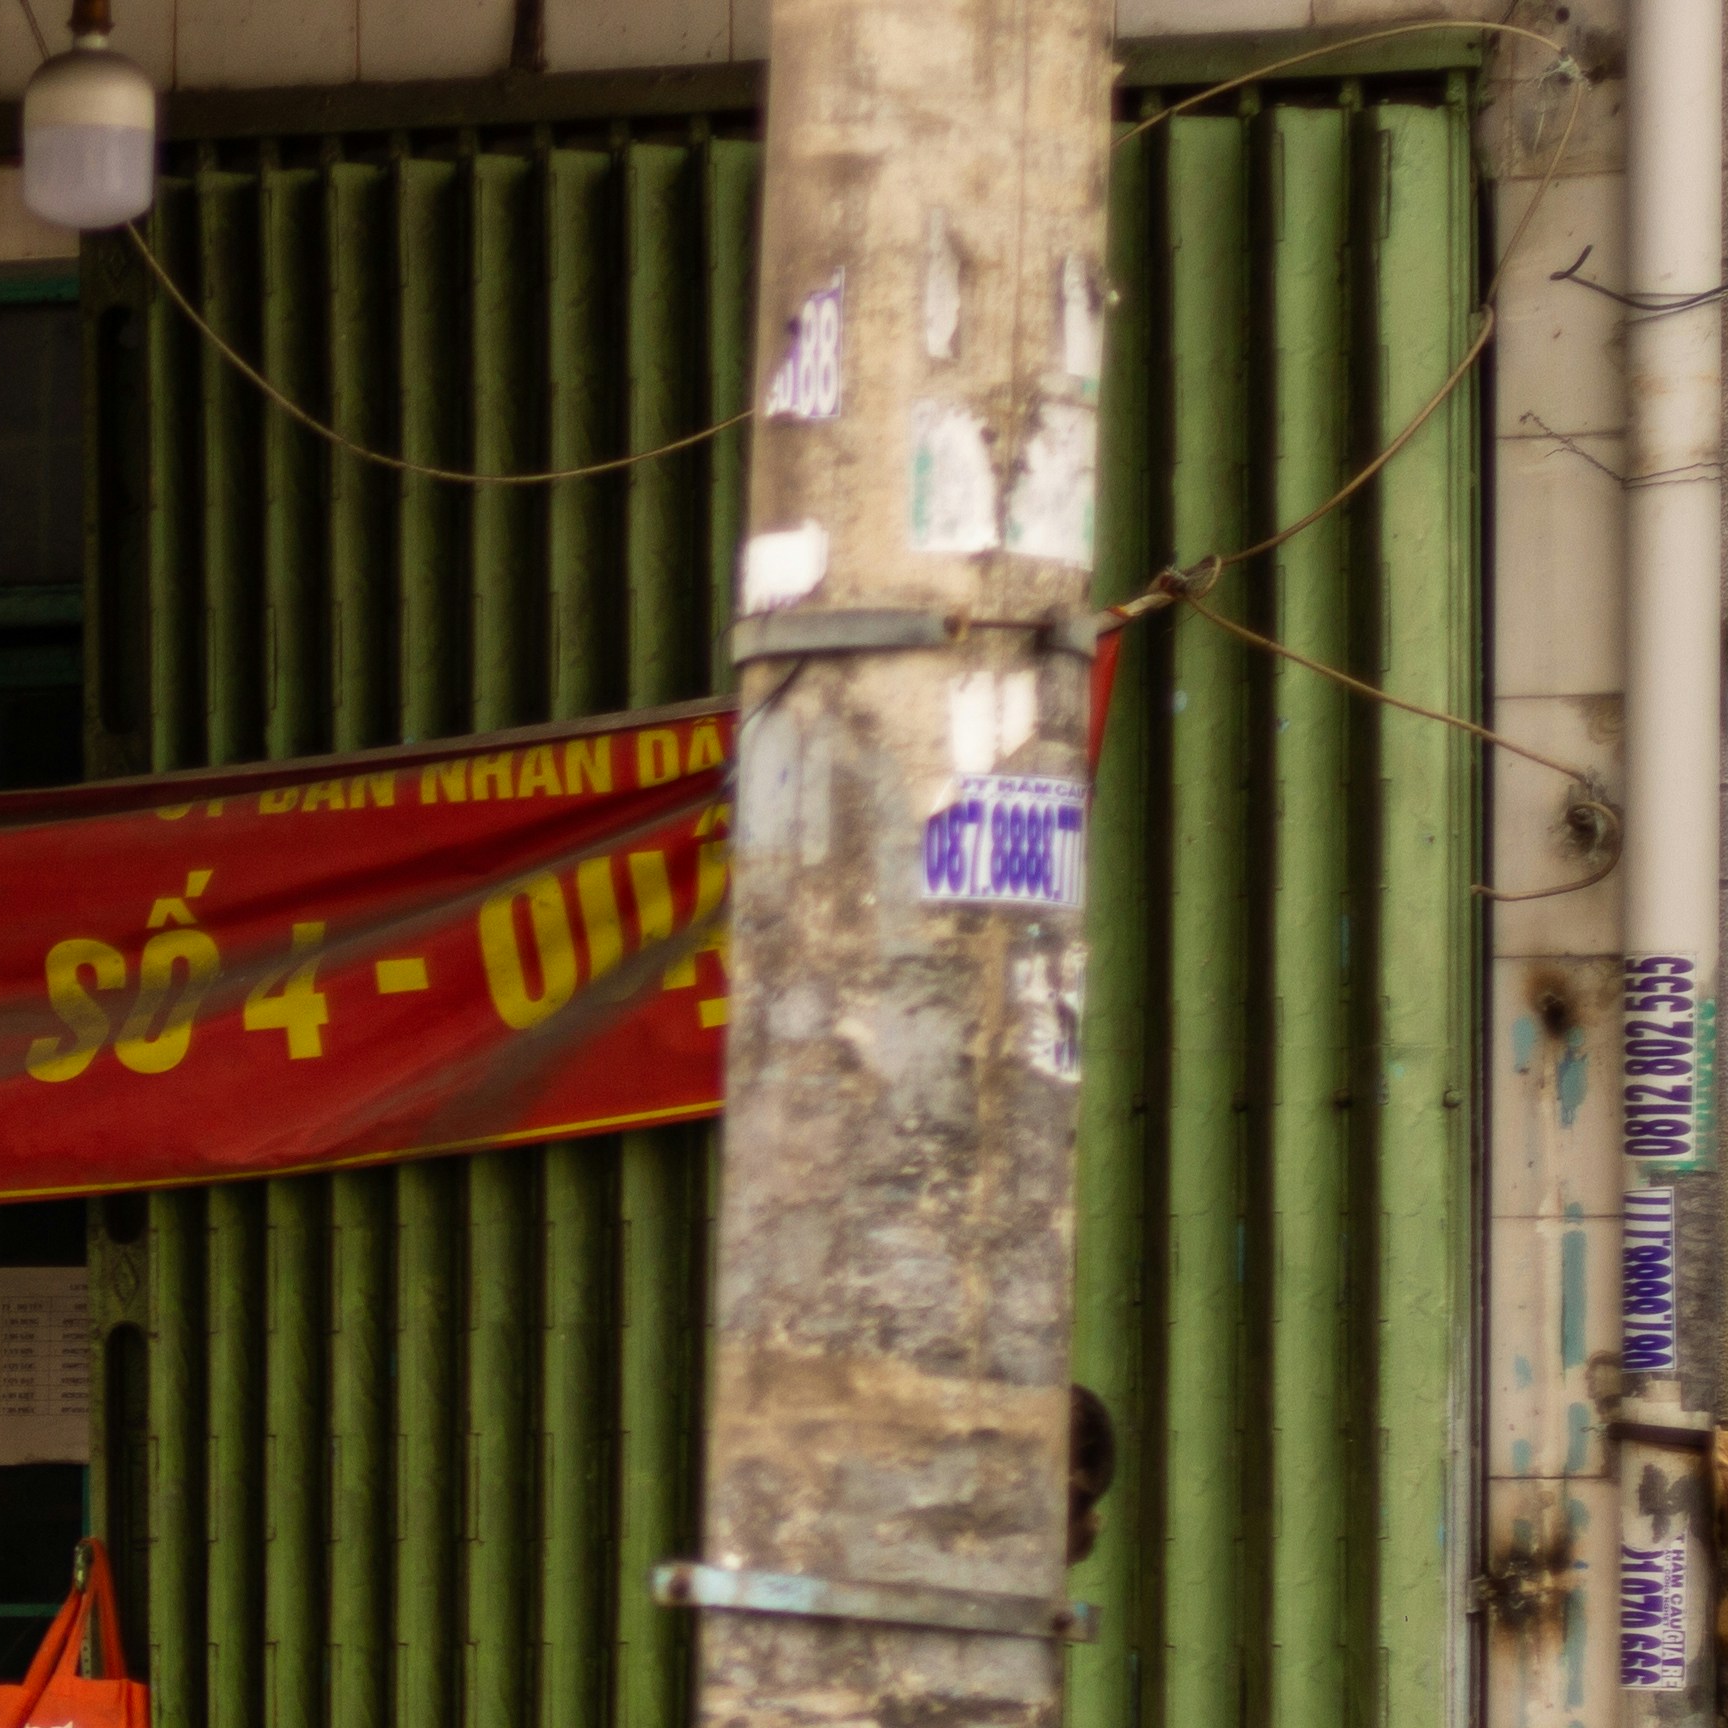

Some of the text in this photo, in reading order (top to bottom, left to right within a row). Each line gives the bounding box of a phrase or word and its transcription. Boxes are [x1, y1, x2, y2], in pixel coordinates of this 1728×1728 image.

[634, 718, 736, 790] DÂ
[24, 869, 224, 1084] SỐ
[241, 921, 333, 1061] 4
[378, 956, 431, 994] -
[1623, 956, 1694, 1158] 0812.802.555
